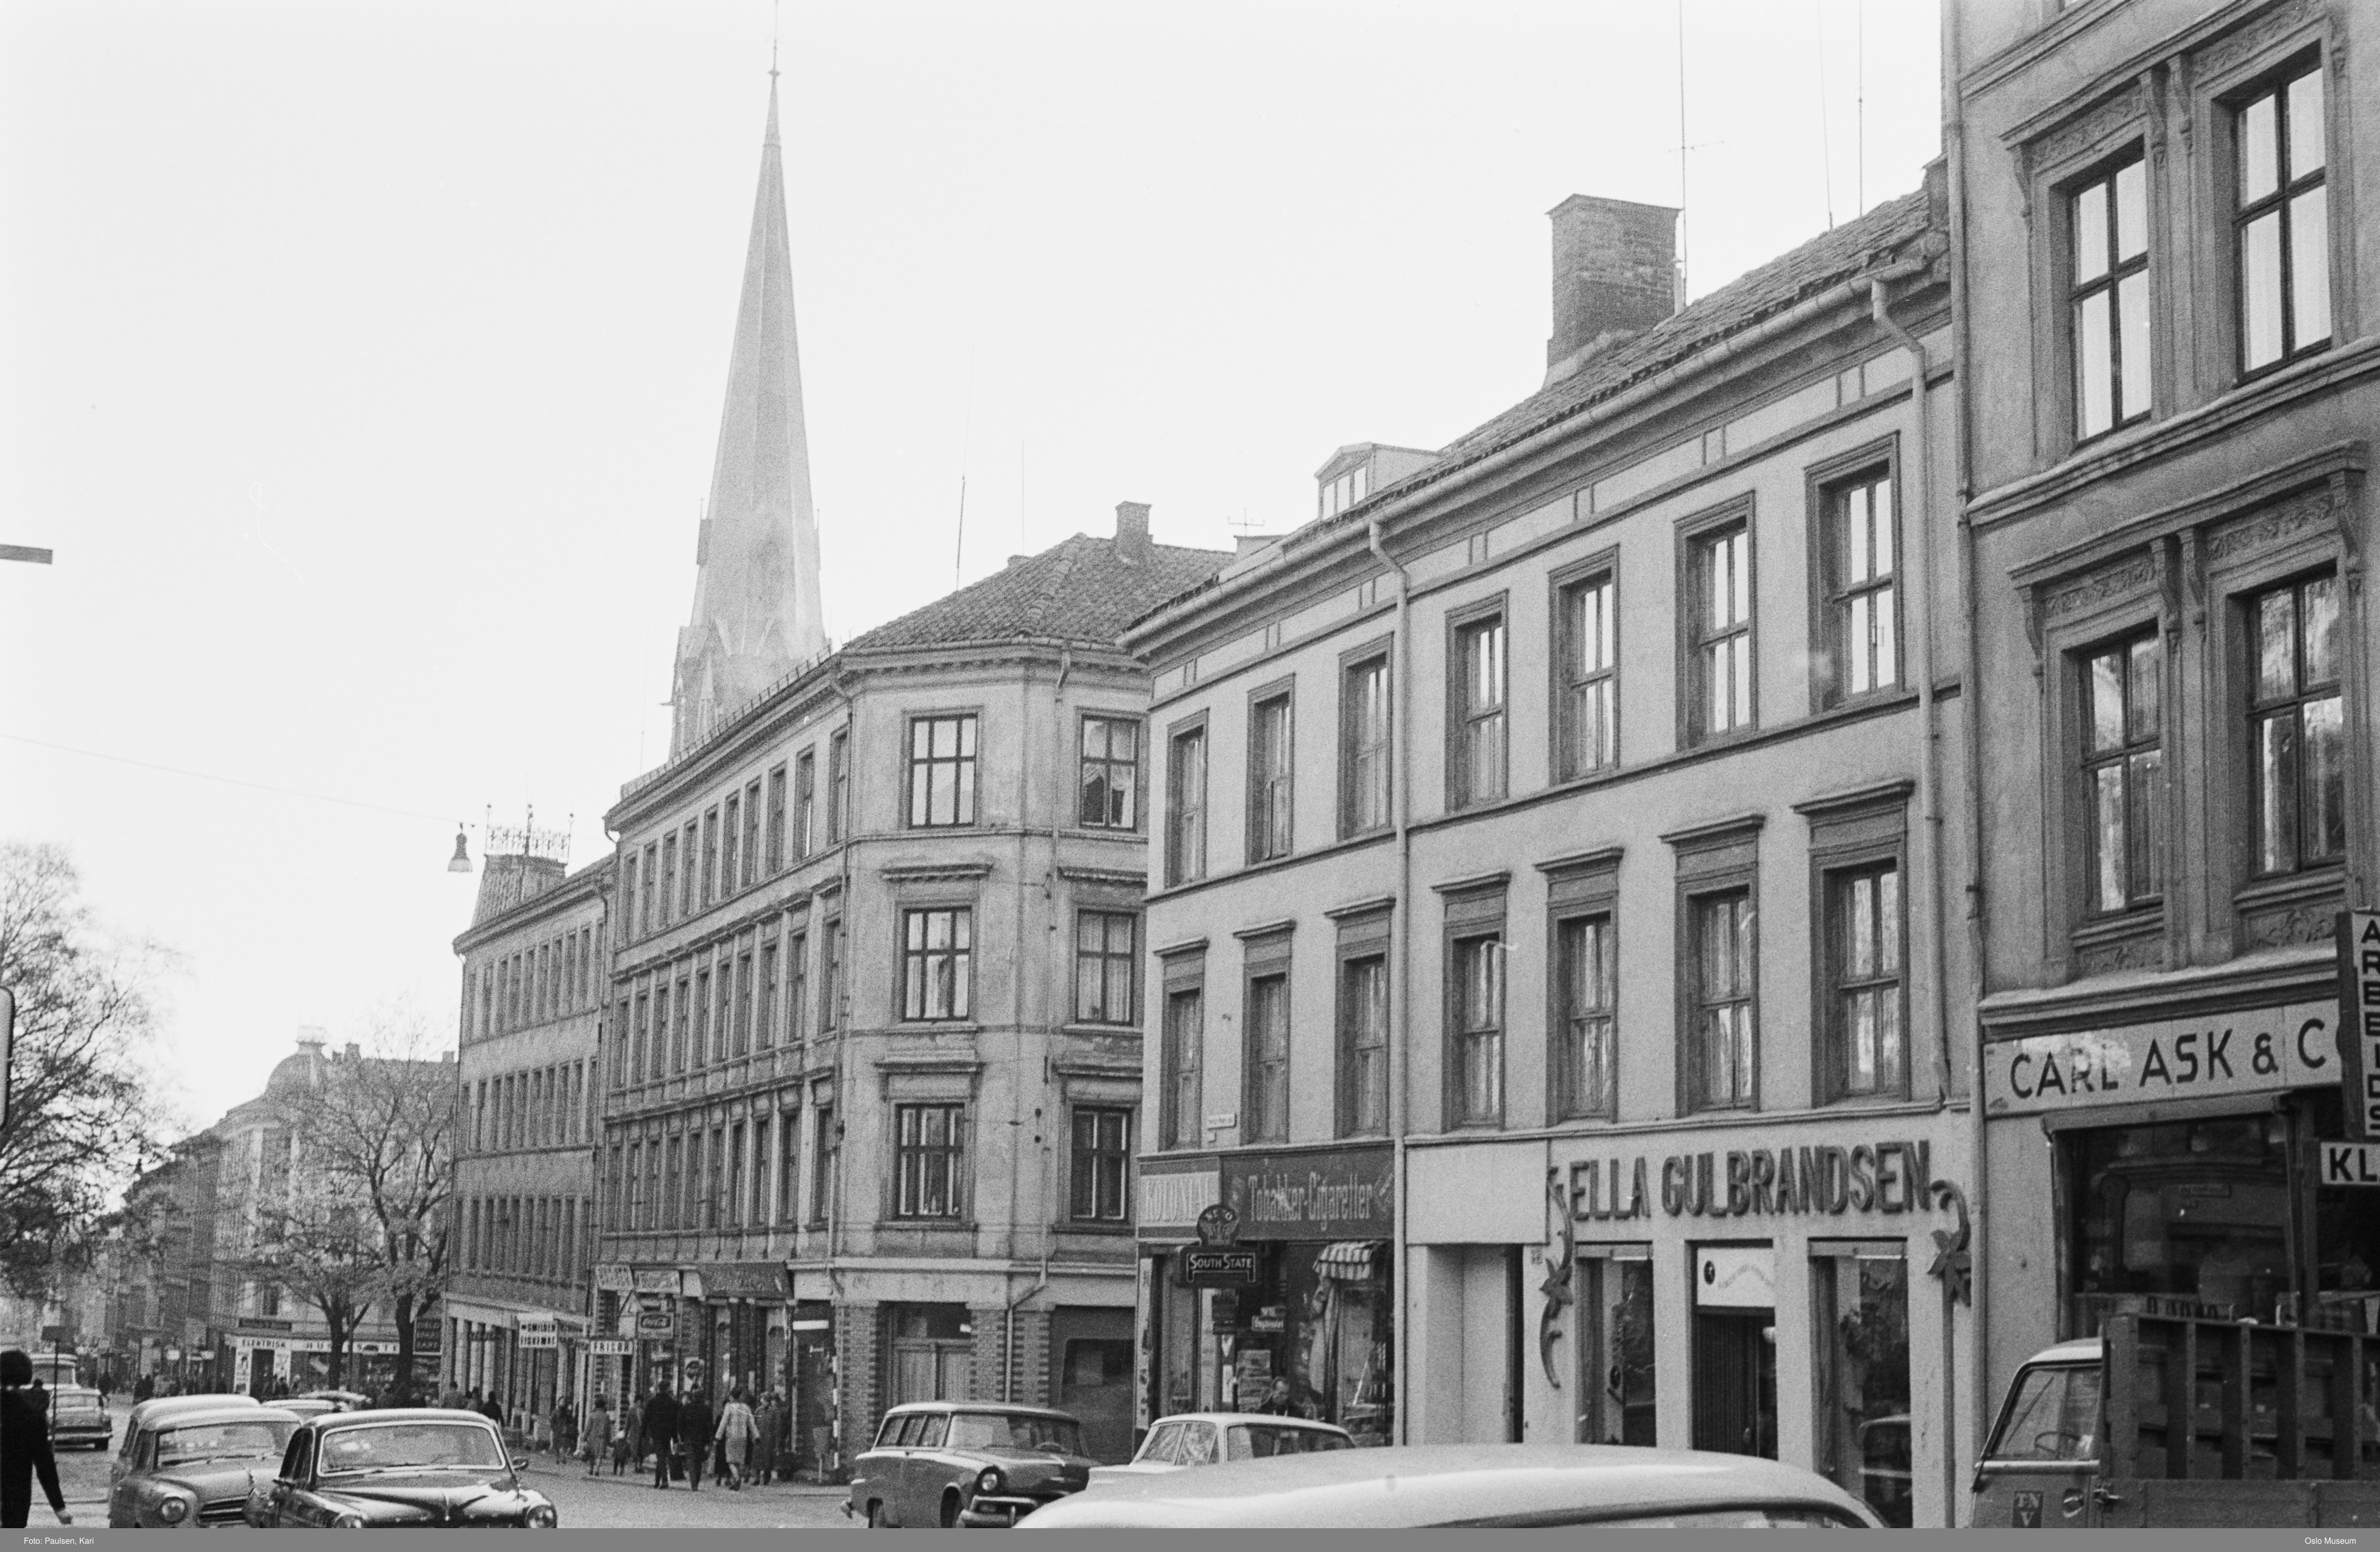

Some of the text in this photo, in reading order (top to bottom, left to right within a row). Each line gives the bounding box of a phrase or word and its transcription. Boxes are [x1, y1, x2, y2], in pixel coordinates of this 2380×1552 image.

[2010, 1018, 2337, 1099] CARL ASK & C
[1569, 1140, 1930, 1221] ELLA GULBRANDSEN
[2329, 1147, 2380, 1182] KL
